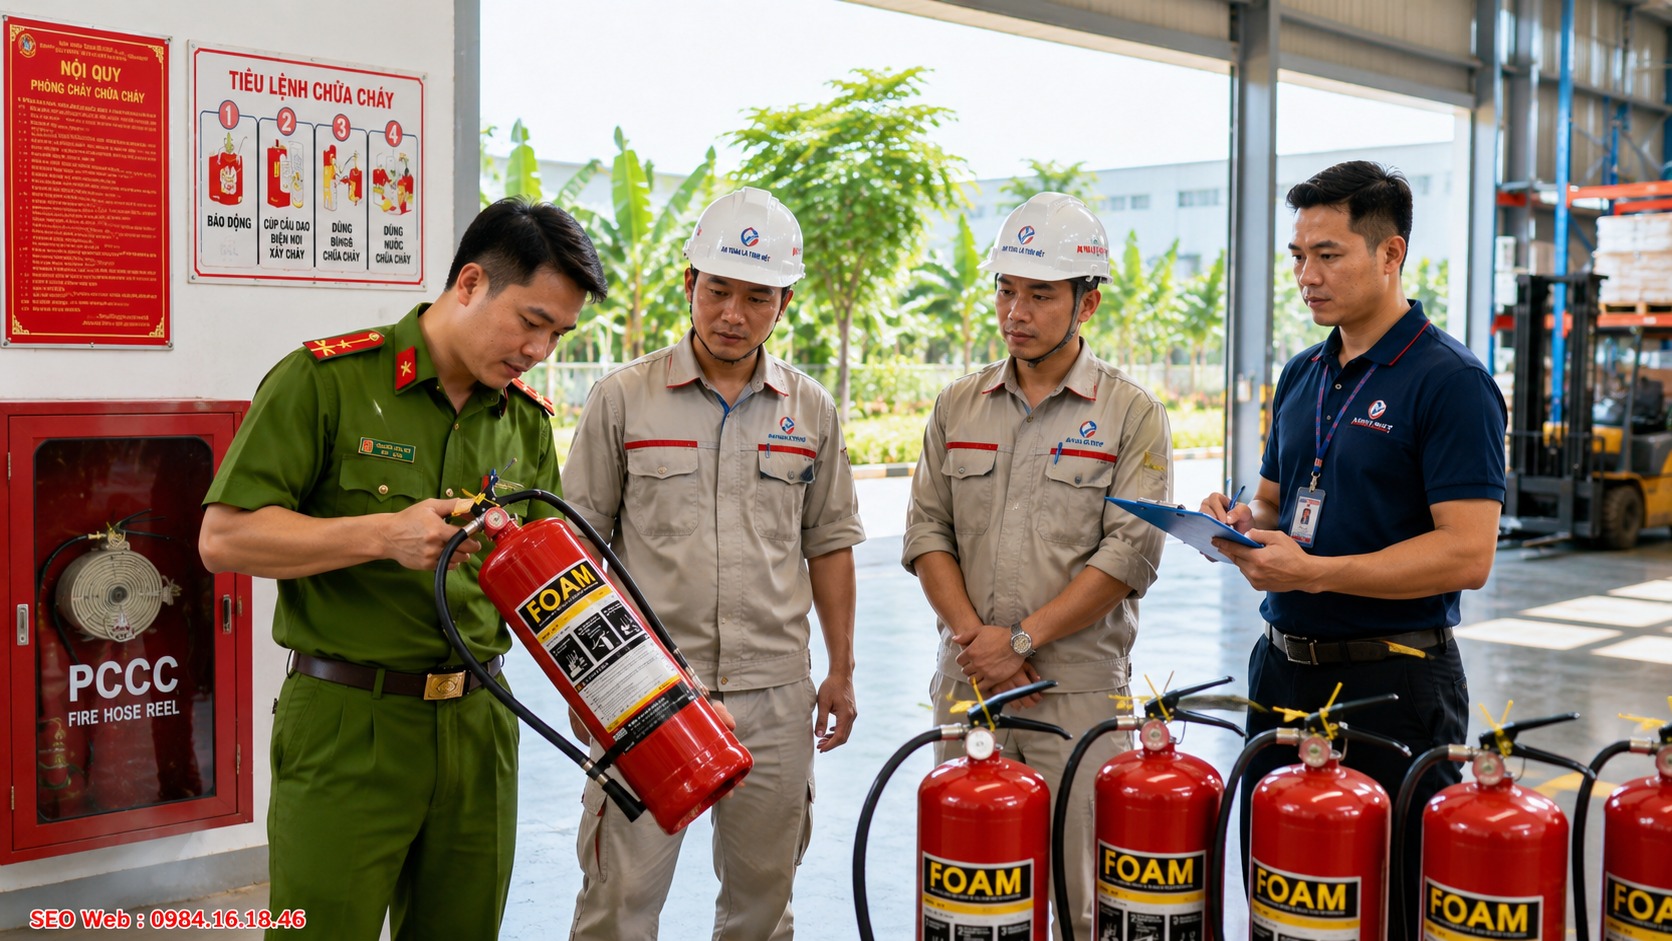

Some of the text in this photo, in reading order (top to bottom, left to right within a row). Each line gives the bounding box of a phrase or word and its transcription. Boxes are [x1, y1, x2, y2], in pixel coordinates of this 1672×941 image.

[91, 64, 121, 82] QUY
[357, 86, 394, 110] CHÁY
[225, 105, 231, 126] 1
[281, 112, 292, 132] 2
[337, 118, 346, 138] 3
[388, 124, 398, 144] 4
[295, 221, 310, 231] DAO
[526, 564, 597, 624] FOAM
[69, 655, 178, 702] PCCC
[68, 700, 180, 727] FIRE HOSE REEL
[930, 861, 1021, 896] FOAM
[1105, 849, 1194, 885] FOAM
[1257, 867, 1346, 910] FOAM
[1431, 886, 1528, 932] FOAM
